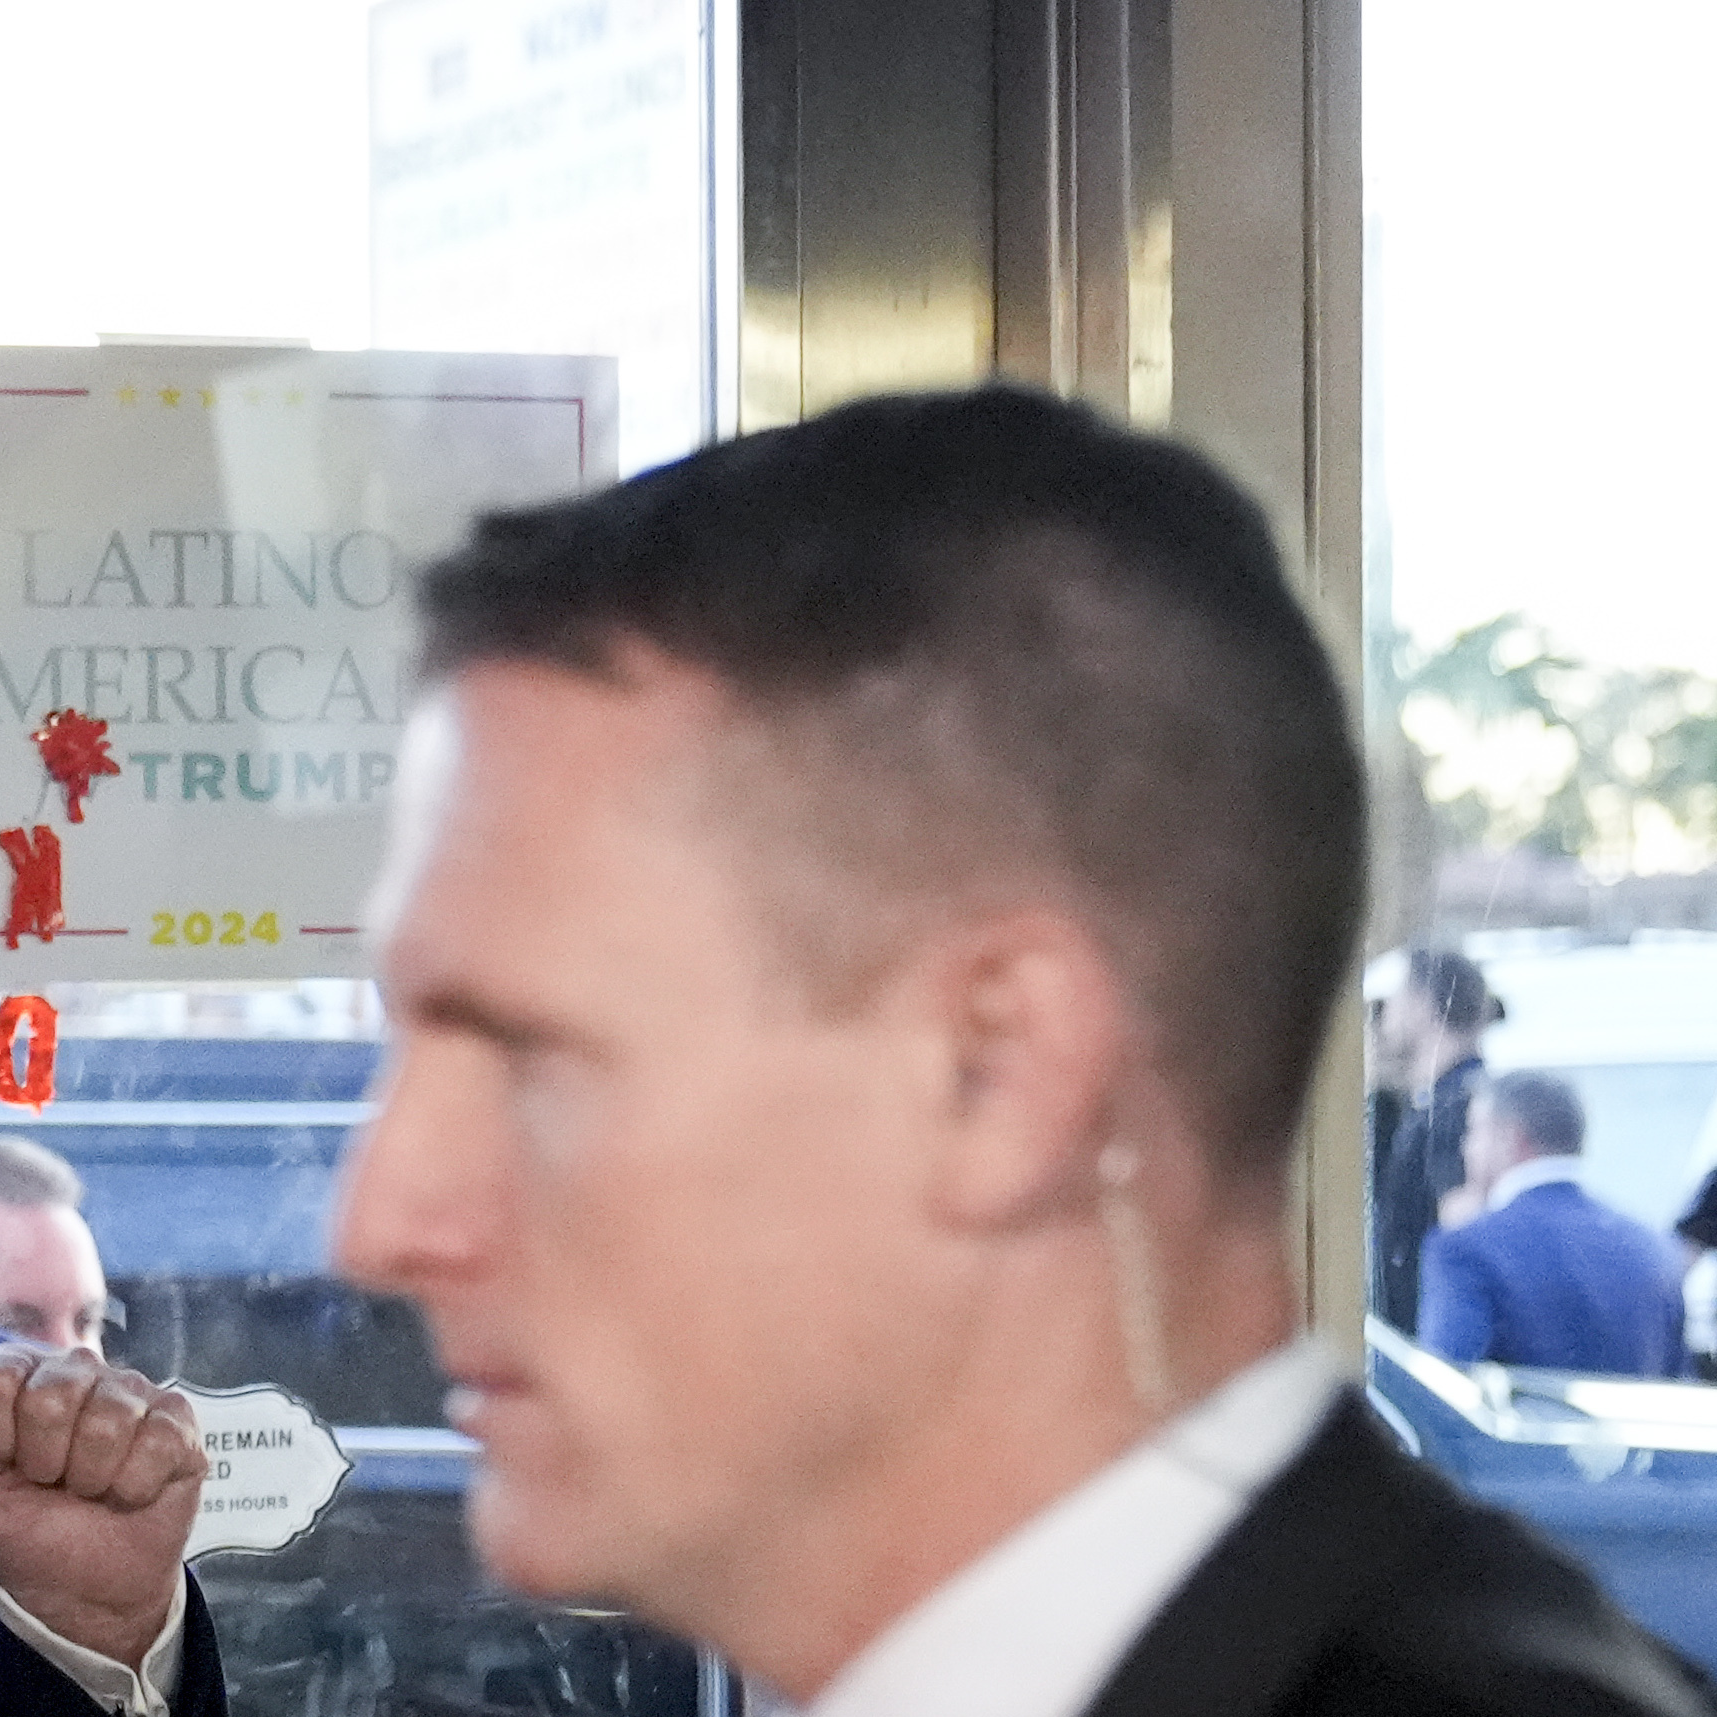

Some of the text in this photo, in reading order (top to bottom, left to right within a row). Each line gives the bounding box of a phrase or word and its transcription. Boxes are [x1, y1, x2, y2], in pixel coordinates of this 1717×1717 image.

[18, 527, 397, 611] LATINO
[129, 751, 398, 803] TRUMP
[149, 911, 283, 947] 2024
[204, 1428, 293, 1452] REMAIN
[229, 1495, 289, 1512] HOURS
